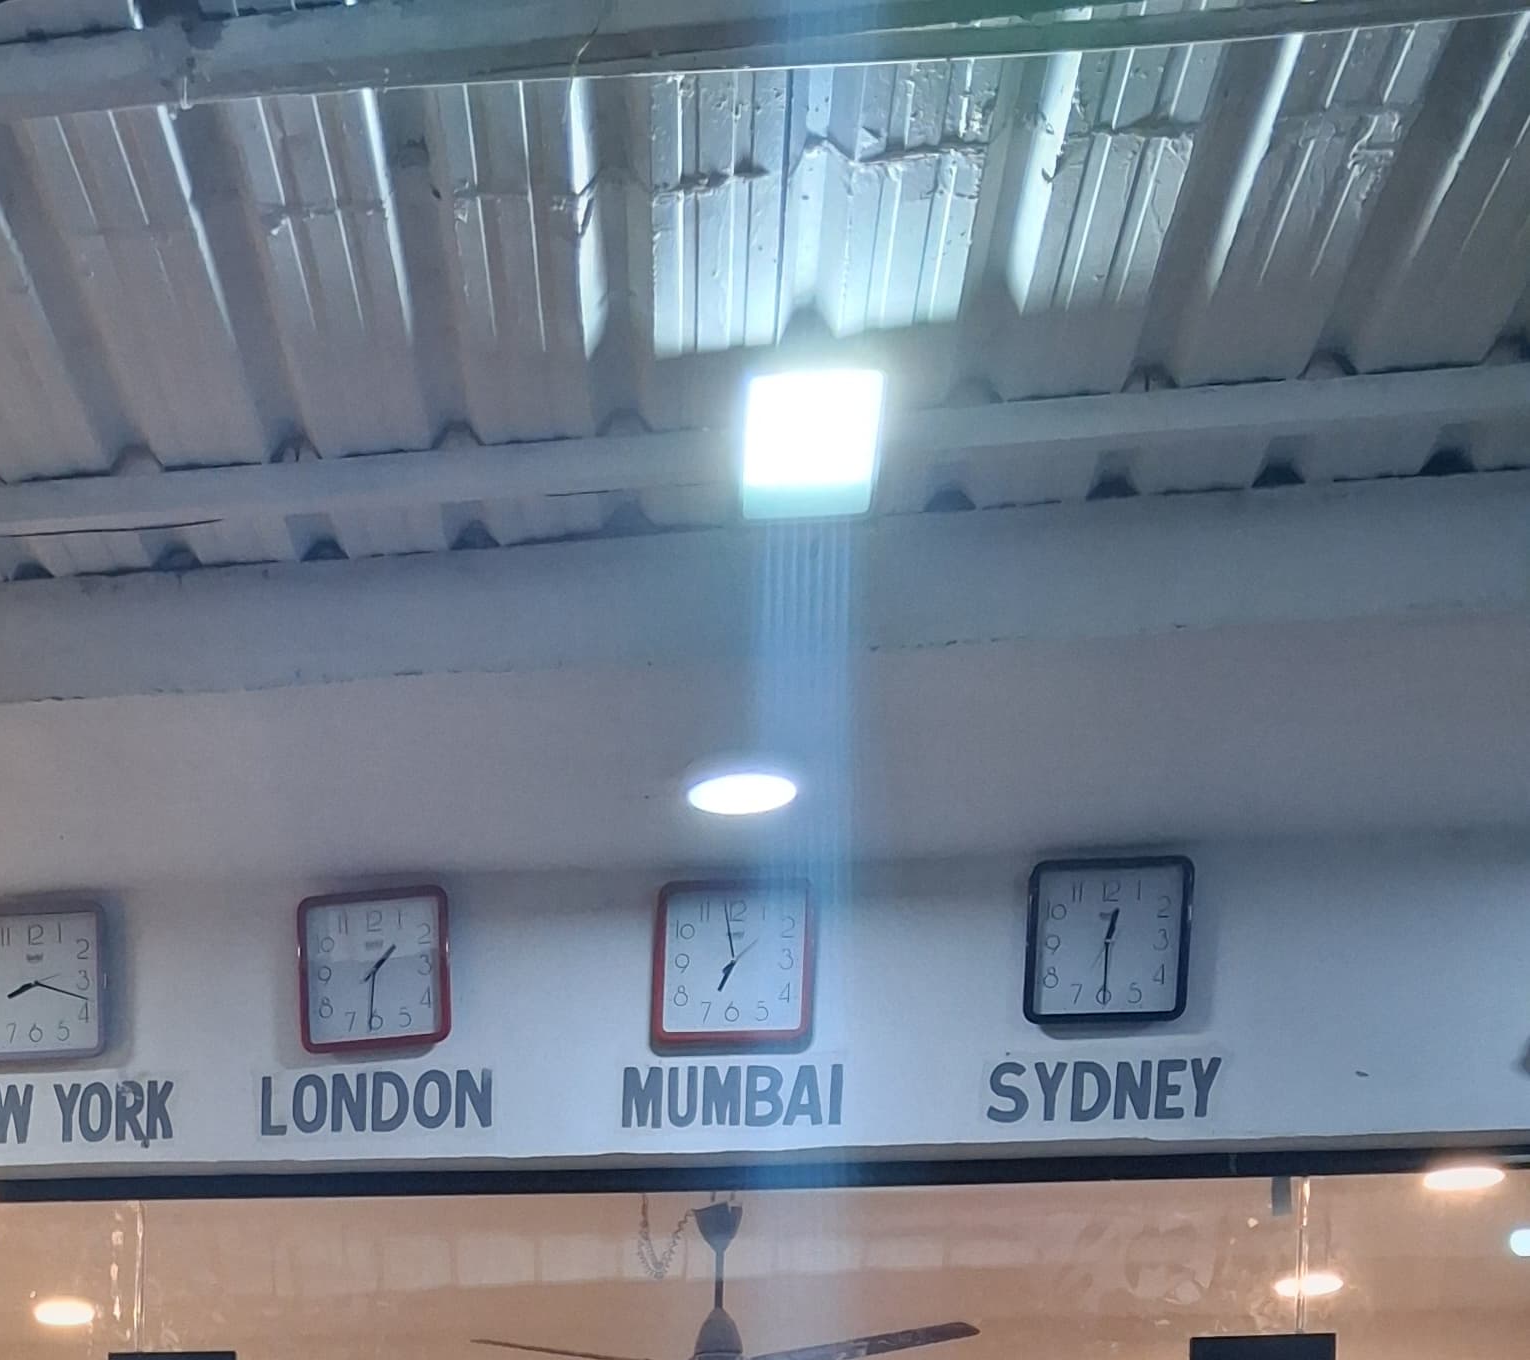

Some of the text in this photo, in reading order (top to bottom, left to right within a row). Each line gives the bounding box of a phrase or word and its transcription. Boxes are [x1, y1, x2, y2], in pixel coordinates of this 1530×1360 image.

[1072, 881, 1083, 903] 11
[1102, 881, 1120, 902] 12
[700, 901, 710, 922] 11
[730, 901, 747, 921] 12
[1047, 900, 1067, 920] 10
[1157, 896, 1171, 918] 2
[339, 912, 348, 935] 11
[366, 911, 382, 932] 12
[676, 919, 695, 940] 10
[781, 916, 795, 938] 2
[1, 928, 10, 946] 11
[28, 924, 43, 945] 12
[317, 934, 334, 953] 10
[417, 923, 430, 945] 2
[1046, 934, 1060, 955] 9
[1153, 928, 1168, 950] 3
[76, 938, 89, 959] 2
[779, 948, 793, 970] 3
[418, 954, 431, 975] 3
[675, 953, 690, 973] 9
[77, 970, 90, 991] 3
[318, 966, 332, 986] 9
[1043, 967, 1058, 988] 8
[1153, 964, 1164, 984] 4
[421, 986, 431, 1009] 4
[674, 985, 688, 1006] 8
[779, 982, 790, 1003] 4
[1071, 984, 1082, 1004] 7
[1096, 986, 1112, 1005] 6
[1128, 982, 1142, 1003] 5
[78, 1001, 89, 1023] 4
[319, 997, 333, 1018] 8
[399, 1007, 412, 1028] 5
[701, 1001, 711, 1023] 7
[725, 1001, 739, 1022] 6
[756, 1001, 769, 1021] 5
[345, 1011, 356, 1032] 7
[368, 1009, 383, 1030] 6
[6, 1022, 16, 1043] 7
[29, 1024, 43, 1042] 6
[58, 1021, 70, 1041] 5
[622, 1064, 844, 1128] MUMBAI
[986, 1057, 1222, 1123] SYDNEY
[261, 1068, 493, 1136] LONDON
[53, 1080, 174, 1147] YORK
